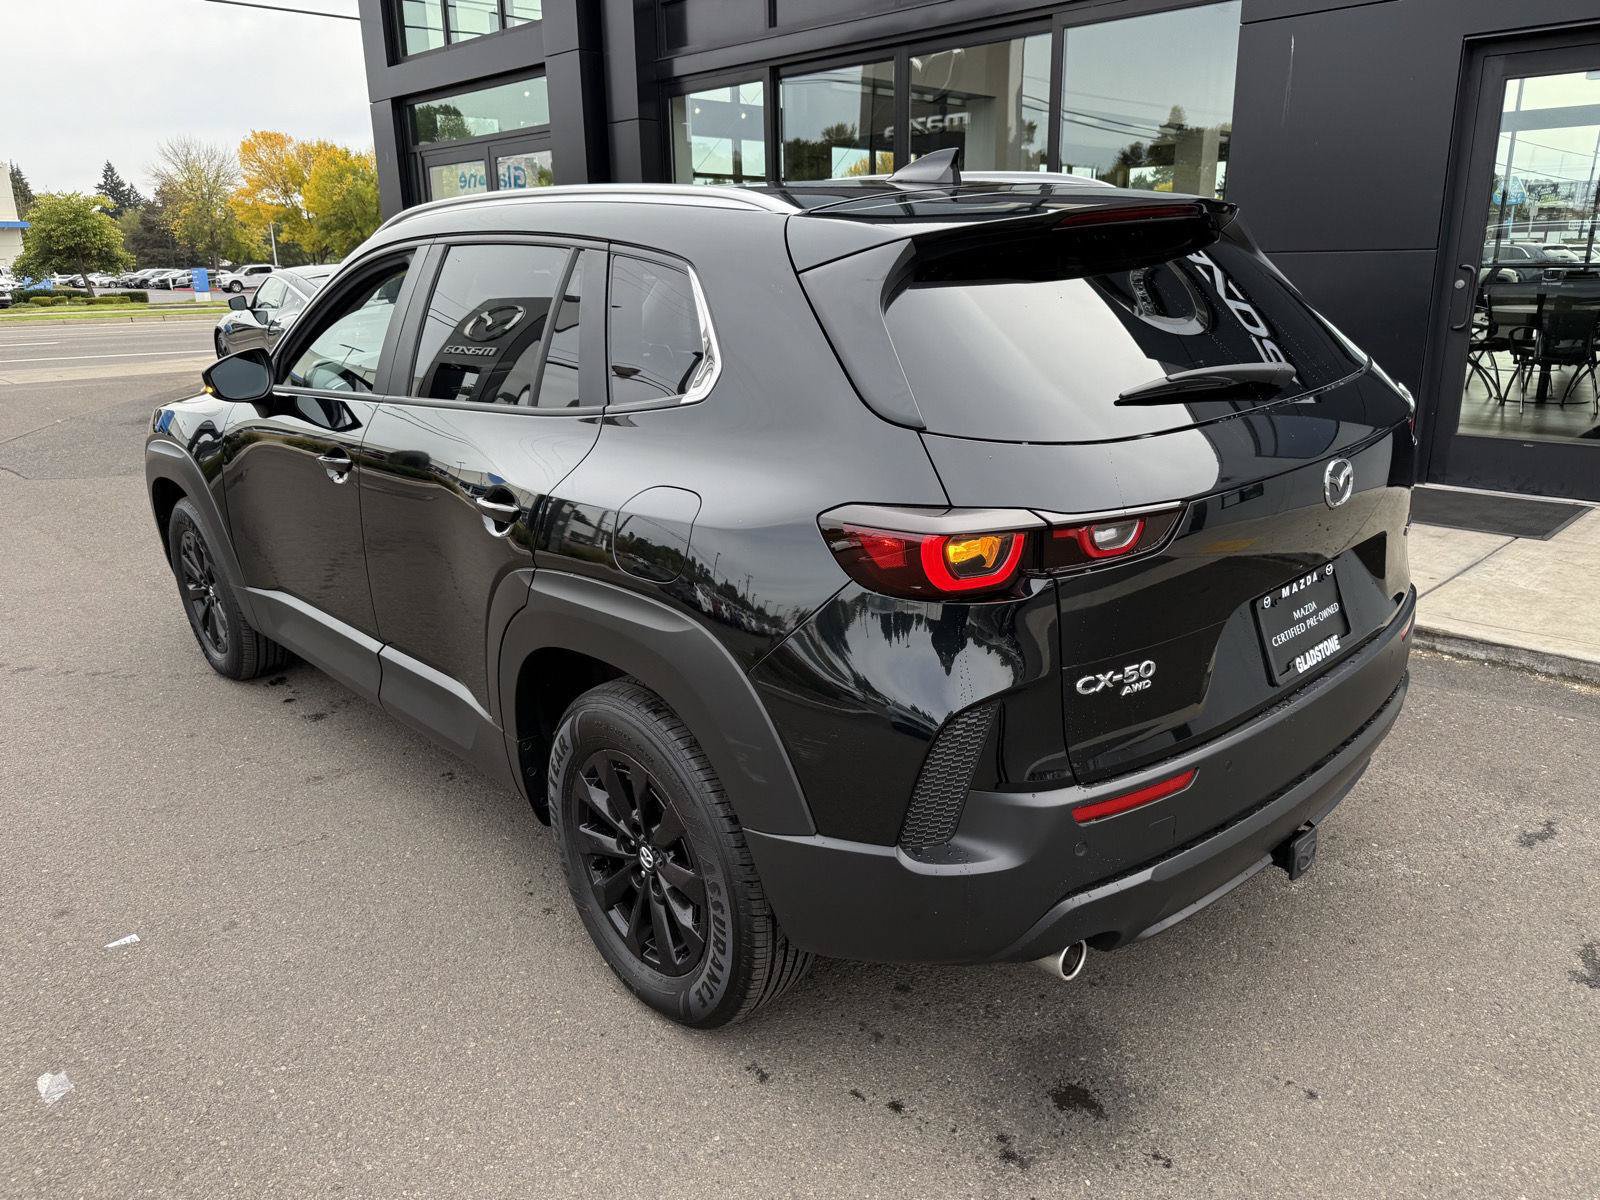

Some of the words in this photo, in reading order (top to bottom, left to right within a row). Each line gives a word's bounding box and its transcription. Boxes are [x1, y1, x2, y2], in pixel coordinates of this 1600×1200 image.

[1281, 571, 1318, 598] MAZDA
[1271, 622, 1306, 647] CERTIFIED
[1306, 602, 1340, 629] PRE-OWNED
[1292, 600, 1318, 621] MAZDA
[1295, 634, 1341, 673] GLADSTONE
[1076, 660, 1156, 695] CX-50
[1121, 679, 1152, 696] AWD
